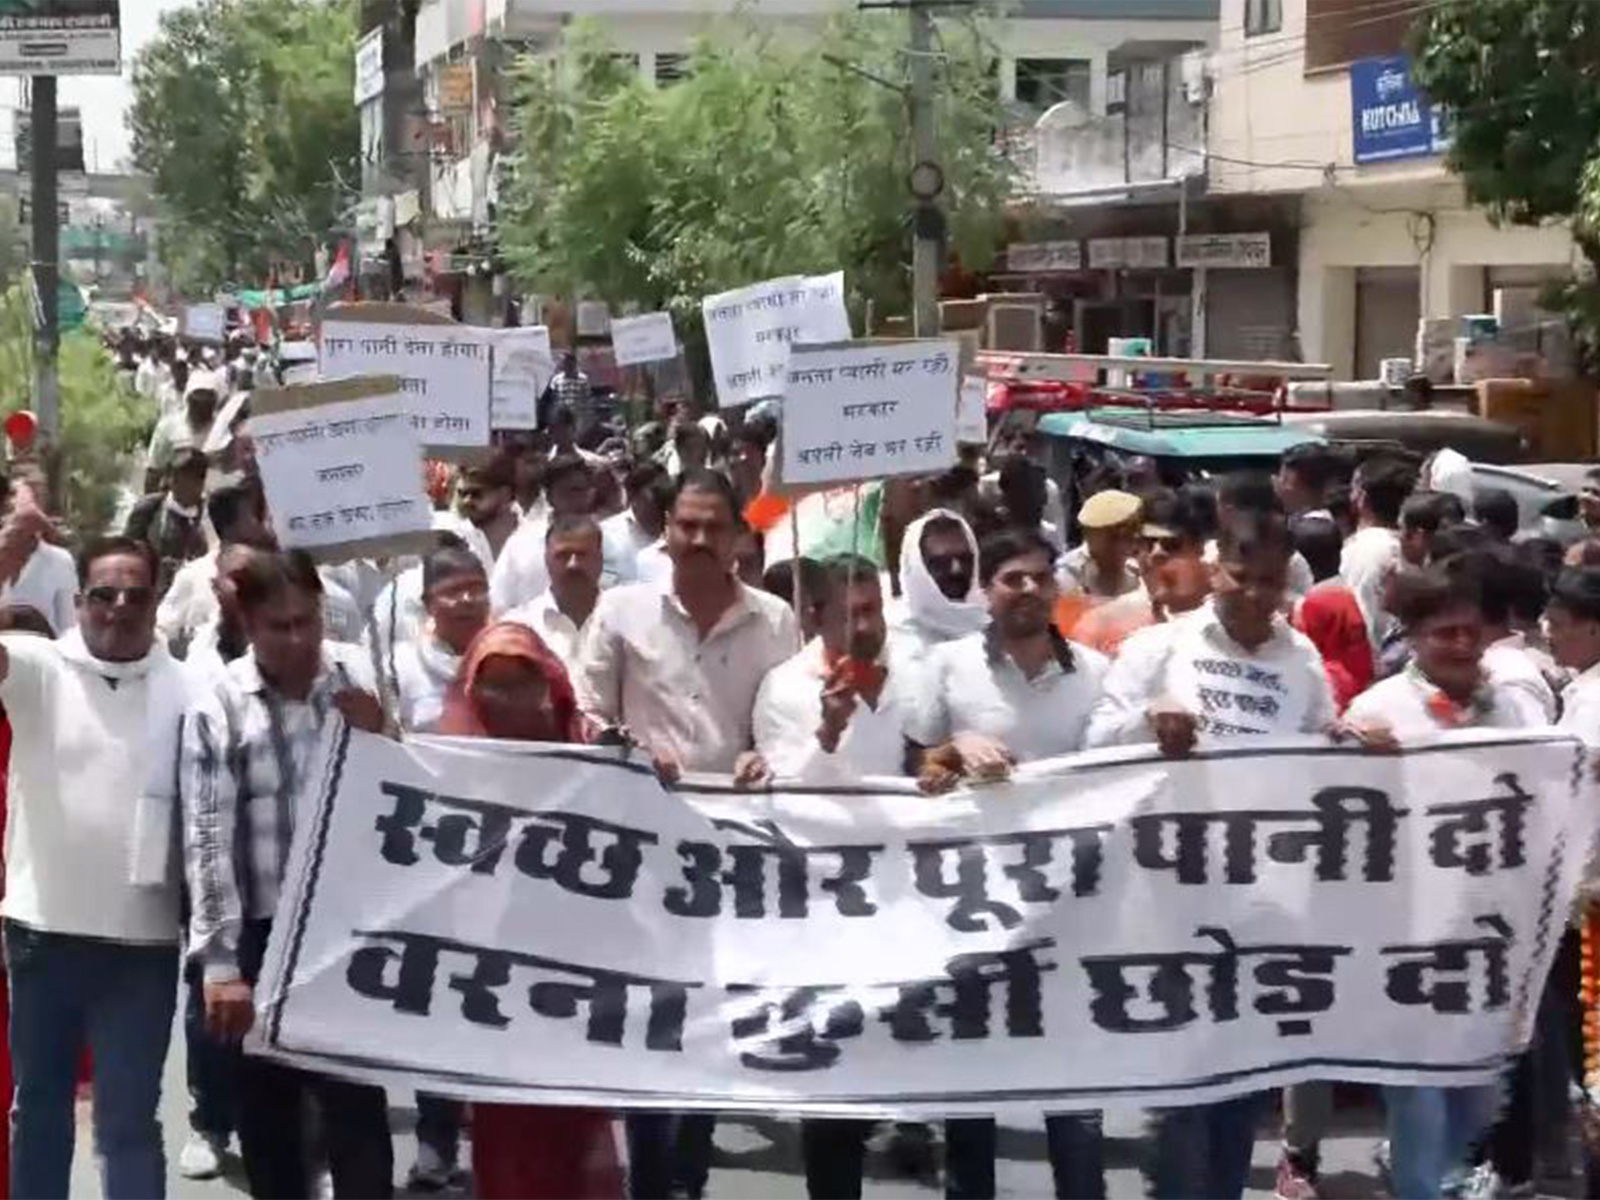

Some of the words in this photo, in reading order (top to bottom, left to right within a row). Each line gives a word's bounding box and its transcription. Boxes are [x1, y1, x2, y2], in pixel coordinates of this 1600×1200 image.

[375, 781, 659, 900] स्वच्छ
[663, 817, 887, 920] और
[904, 824, 1114, 933] पूरा
[1129, 785, 1410, 886] पानी
[1426, 772, 1533, 875] दो
[346, 930, 705, 1052] वरना
[725, 937, 1057, 1072] कुर्सी
[1081, 926, 1352, 1037] छोड़
[1380, 914, 1514, 1014] दो
